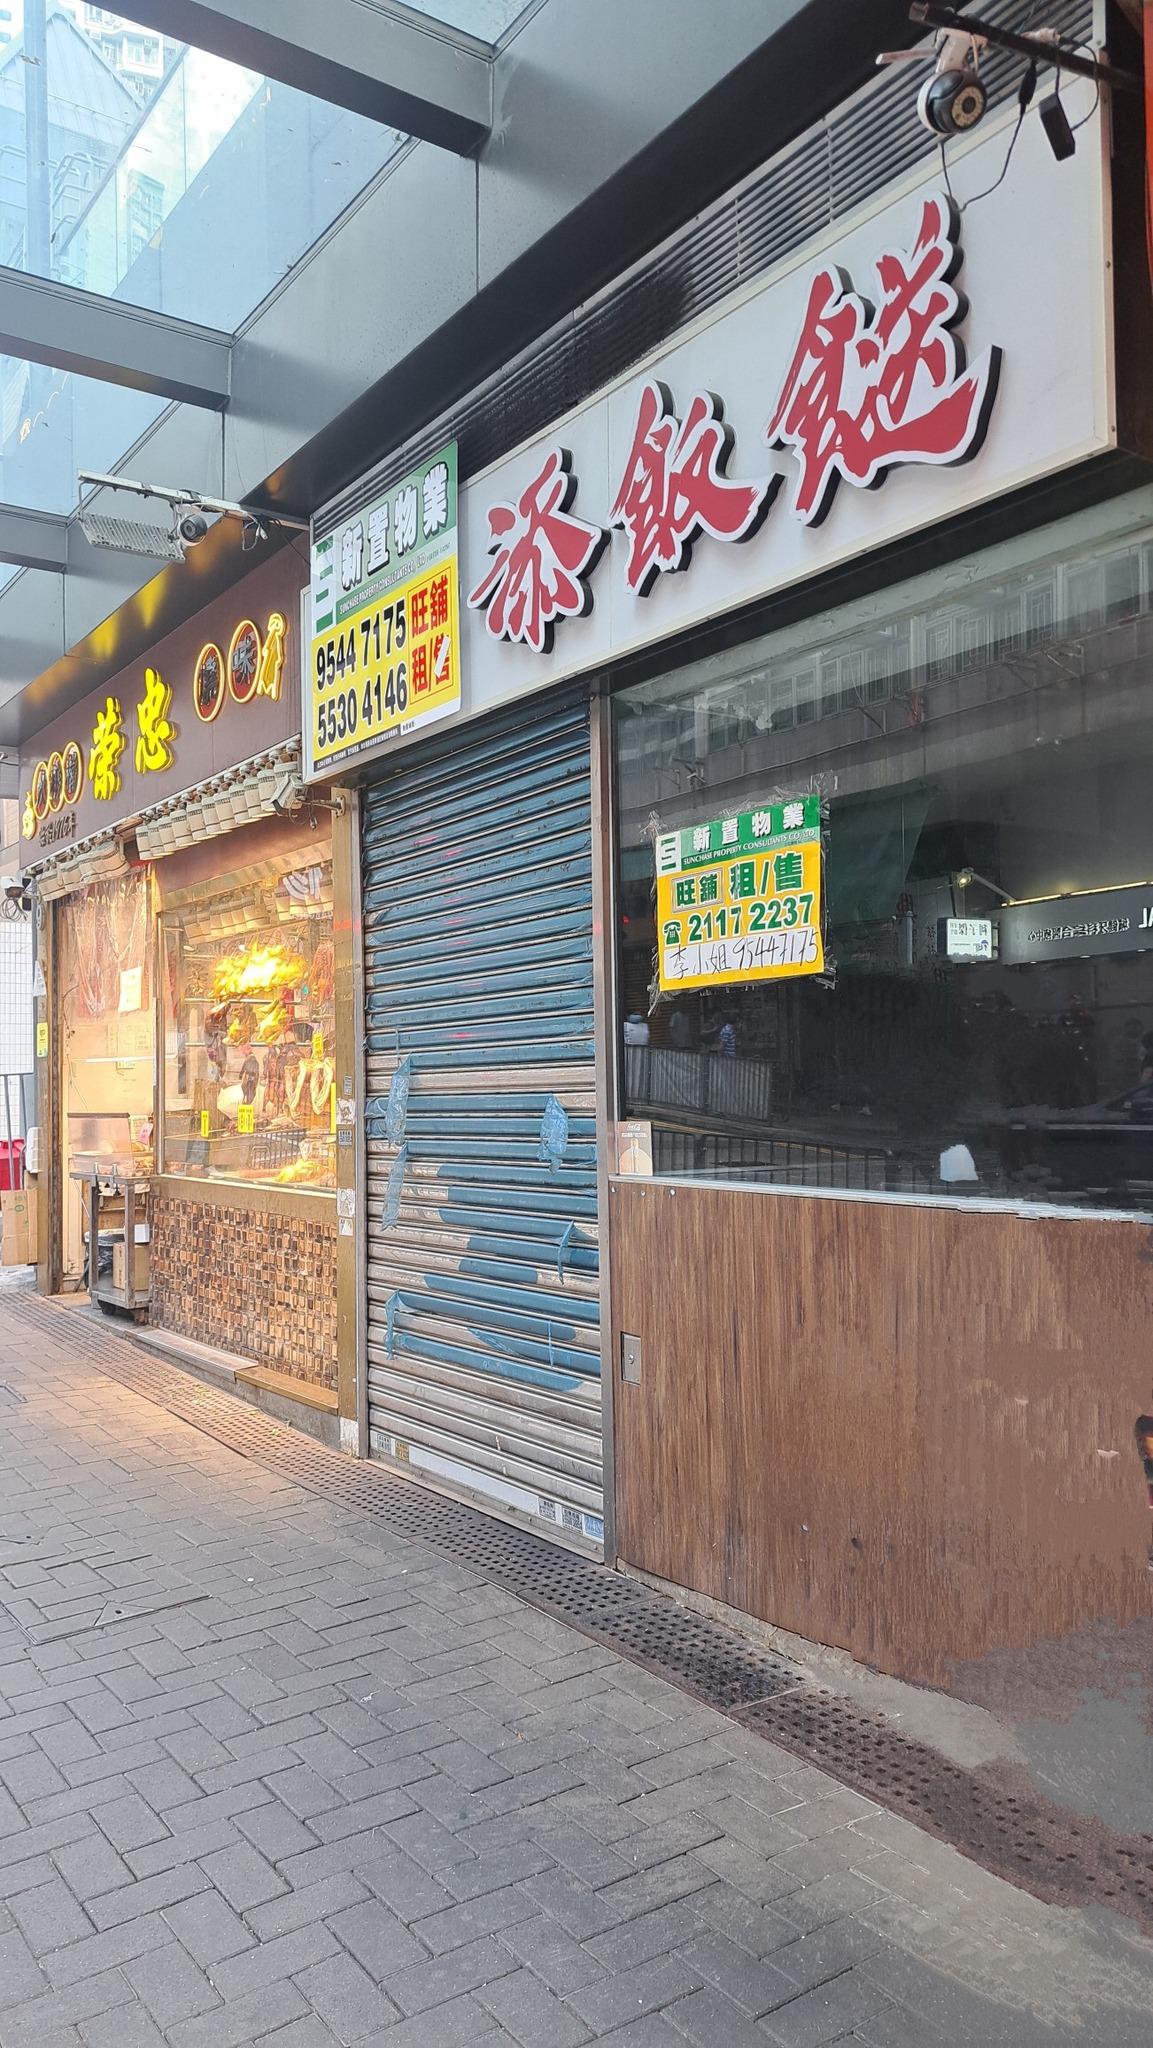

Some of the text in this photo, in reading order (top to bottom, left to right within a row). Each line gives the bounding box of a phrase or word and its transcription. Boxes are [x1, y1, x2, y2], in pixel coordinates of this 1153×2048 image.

[341, 462, 449, 592] 新置物業
[411, 575, 449, 638] 旺舖
[316, 598, 407, 692] 9544 7175
[317, 686, 357, 750] 5530
[361, 663, 408, 729] 4146
[683, 852, 713, 866] SUNCHASE
[713, 846, 742, 859] PROPERTY
[742, 835, 788, 851] CONSULTANTS
[693, 802, 806, 852] 新置物業
[676, 852, 803, 906] 旺舖 租/售
[688, 894, 813, 942] 2117 2237
[670, 931, 819, 979] 李小姐 95447175
